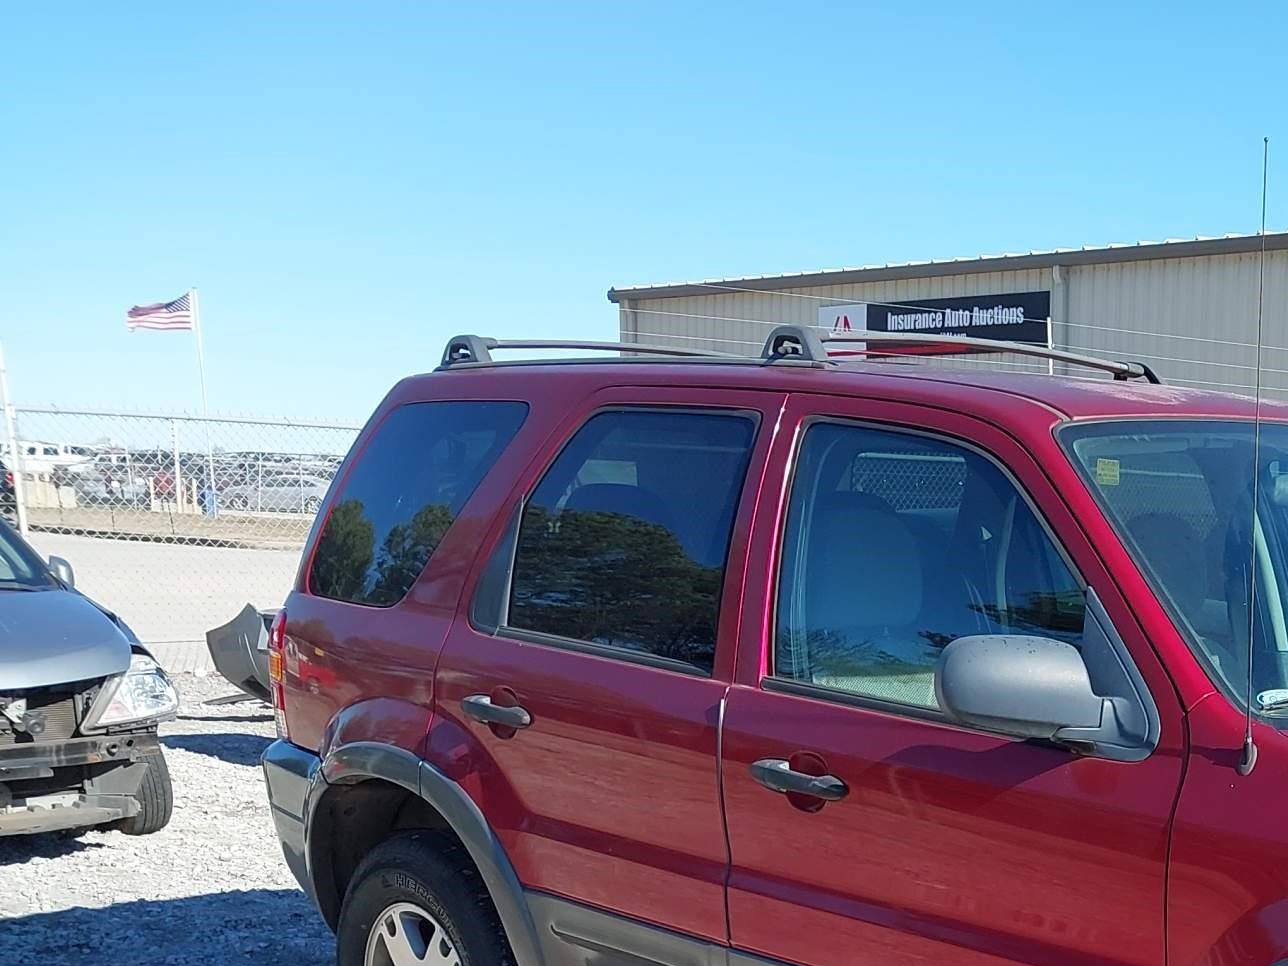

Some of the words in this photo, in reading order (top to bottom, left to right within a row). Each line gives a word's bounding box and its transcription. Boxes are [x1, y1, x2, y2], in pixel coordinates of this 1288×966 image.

[887, 312, 943, 331] Insurance
[944, 308, 970, 328] Auto
[971, 304, 1025, 327] Auctions
